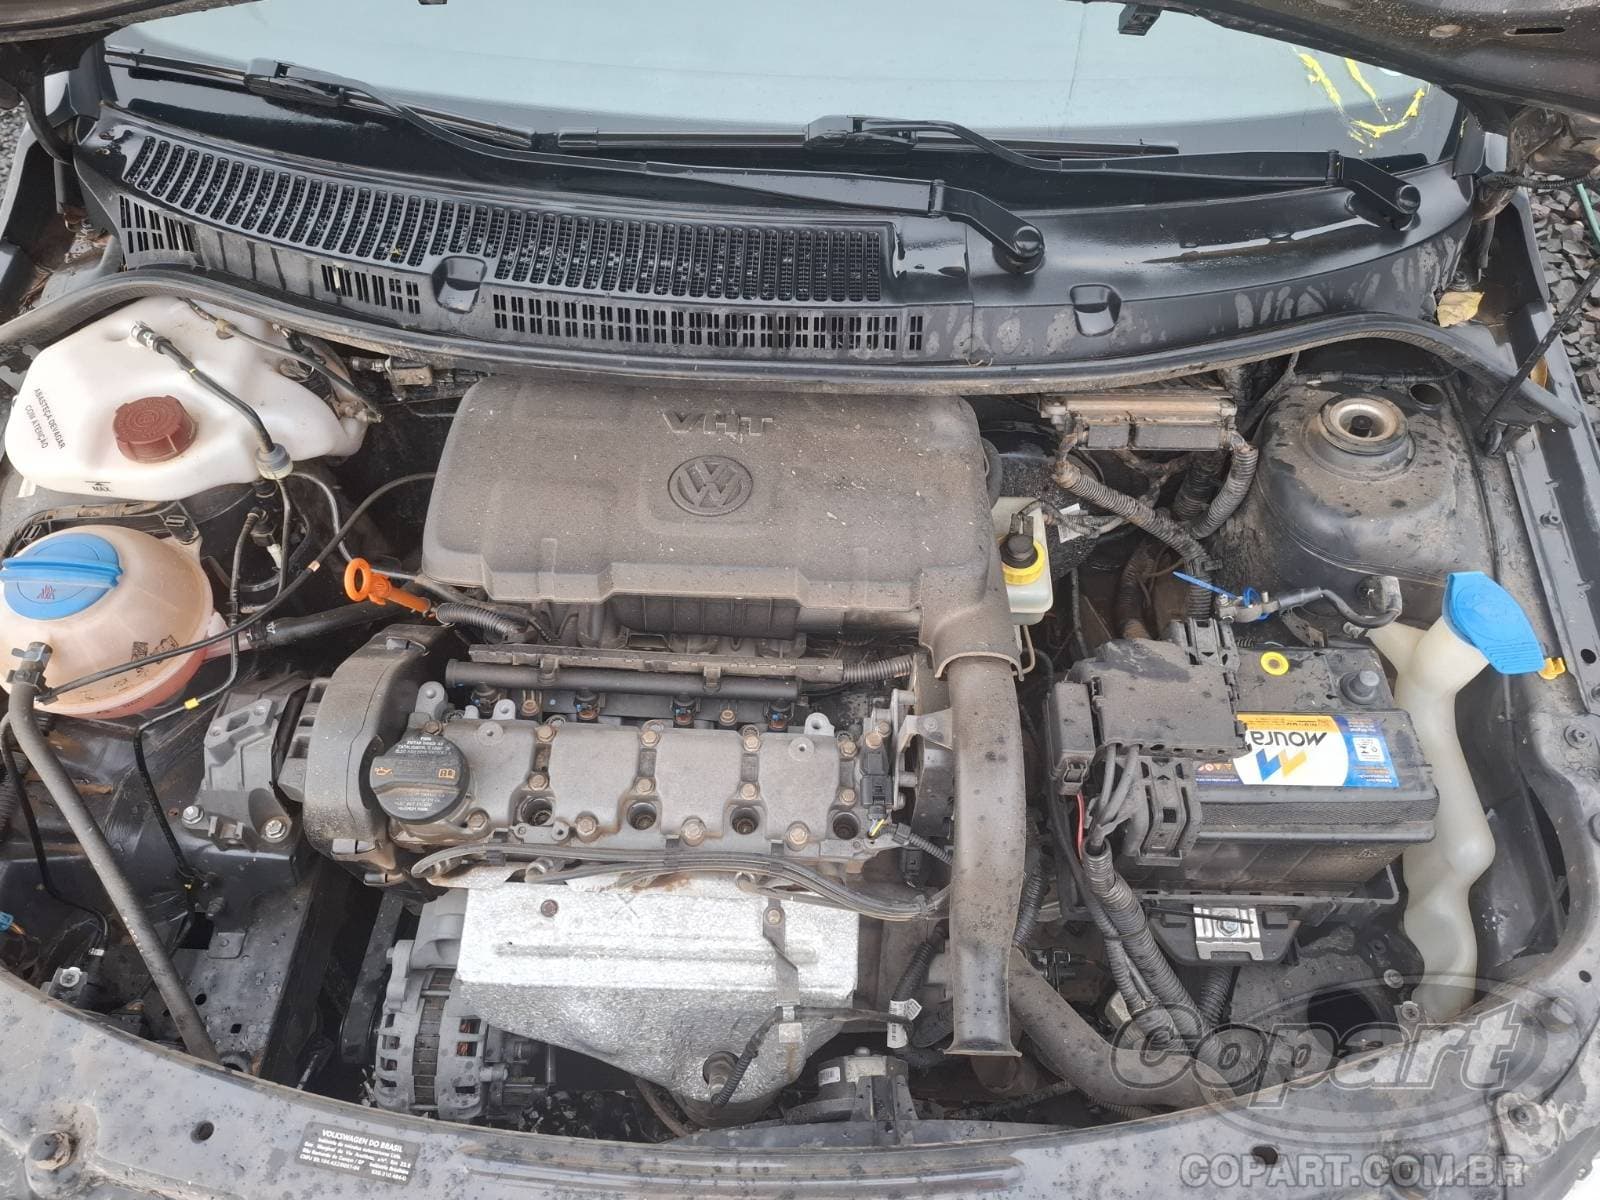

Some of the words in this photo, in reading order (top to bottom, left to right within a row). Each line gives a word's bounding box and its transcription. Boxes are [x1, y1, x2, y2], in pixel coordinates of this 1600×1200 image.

[322, 1129, 369, 1146] VOLKSWAGEN
[368, 1139, 379, 1148] DO
[380, 1141, 403, 1153] BRASIL
